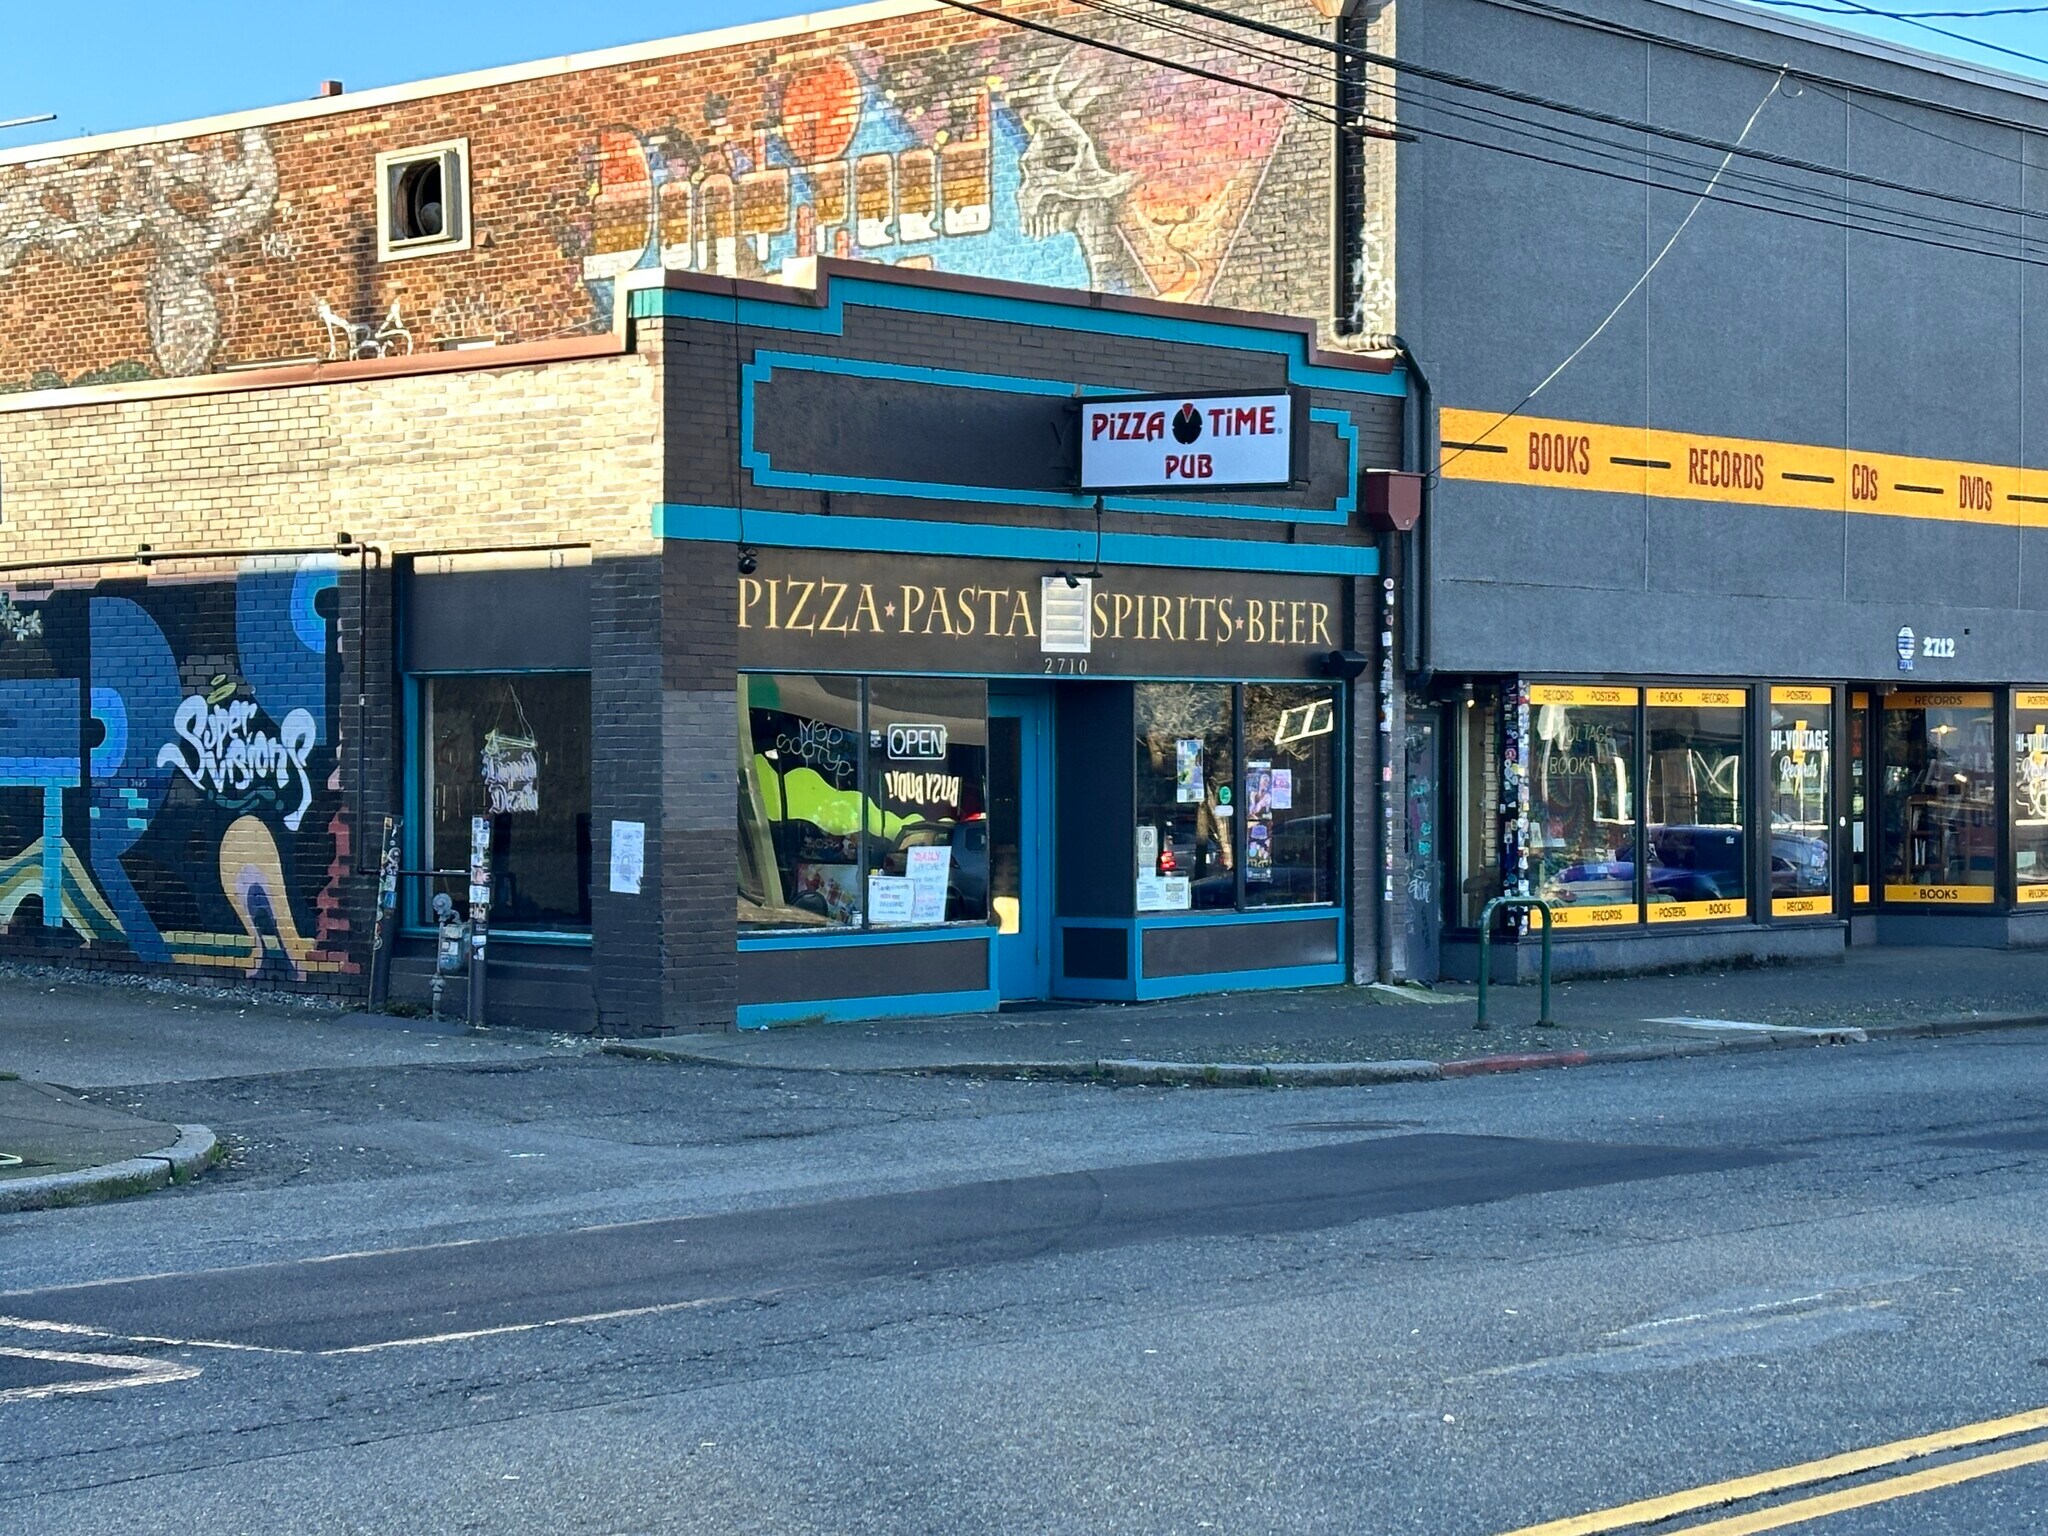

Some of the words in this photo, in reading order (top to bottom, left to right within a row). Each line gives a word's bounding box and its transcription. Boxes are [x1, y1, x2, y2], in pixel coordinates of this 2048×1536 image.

[1528, 432, 1590, 475] BOOKS
[1165, 453, 1213, 479] PUB
[1688, 448, 1764, 490] RECORDS
[737, 574, 885, 638] PIZZA
[898, 583, 1037, 640] PASTA
[1092, 590, 1234, 646] SPIRITS
[1245, 599, 1333, 646] BEER
[1922, 636, 1956, 658] 2712
[1044, 657, 1088, 675] 2710
[1543, 690, 1575, 702] RECORDS
[1591, 691, 1620, 702] POSTERS
[1659, 692, 1683, 703] BOOKS
[1701, 693, 1729, 704] RECORDS
[1786, 690, 1812, 701] POSTERS
[1914, 695, 1964, 706] RECORDS
[890, 728, 944, 755] OPEN
[1771, 730, 1829, 751] HI-VOLTAGE
[488, 782, 539, 814] Death
[1919, 888, 1958, 899] BOOKS
[1658, 906, 1687, 918] POSTERS
[1708, 903, 1731, 915] BOOKS
[1787, 900, 1814, 912] RECORDS
[1550, 912, 1568, 924] OOKS
[1591, 909, 1623, 922] RECORDS
